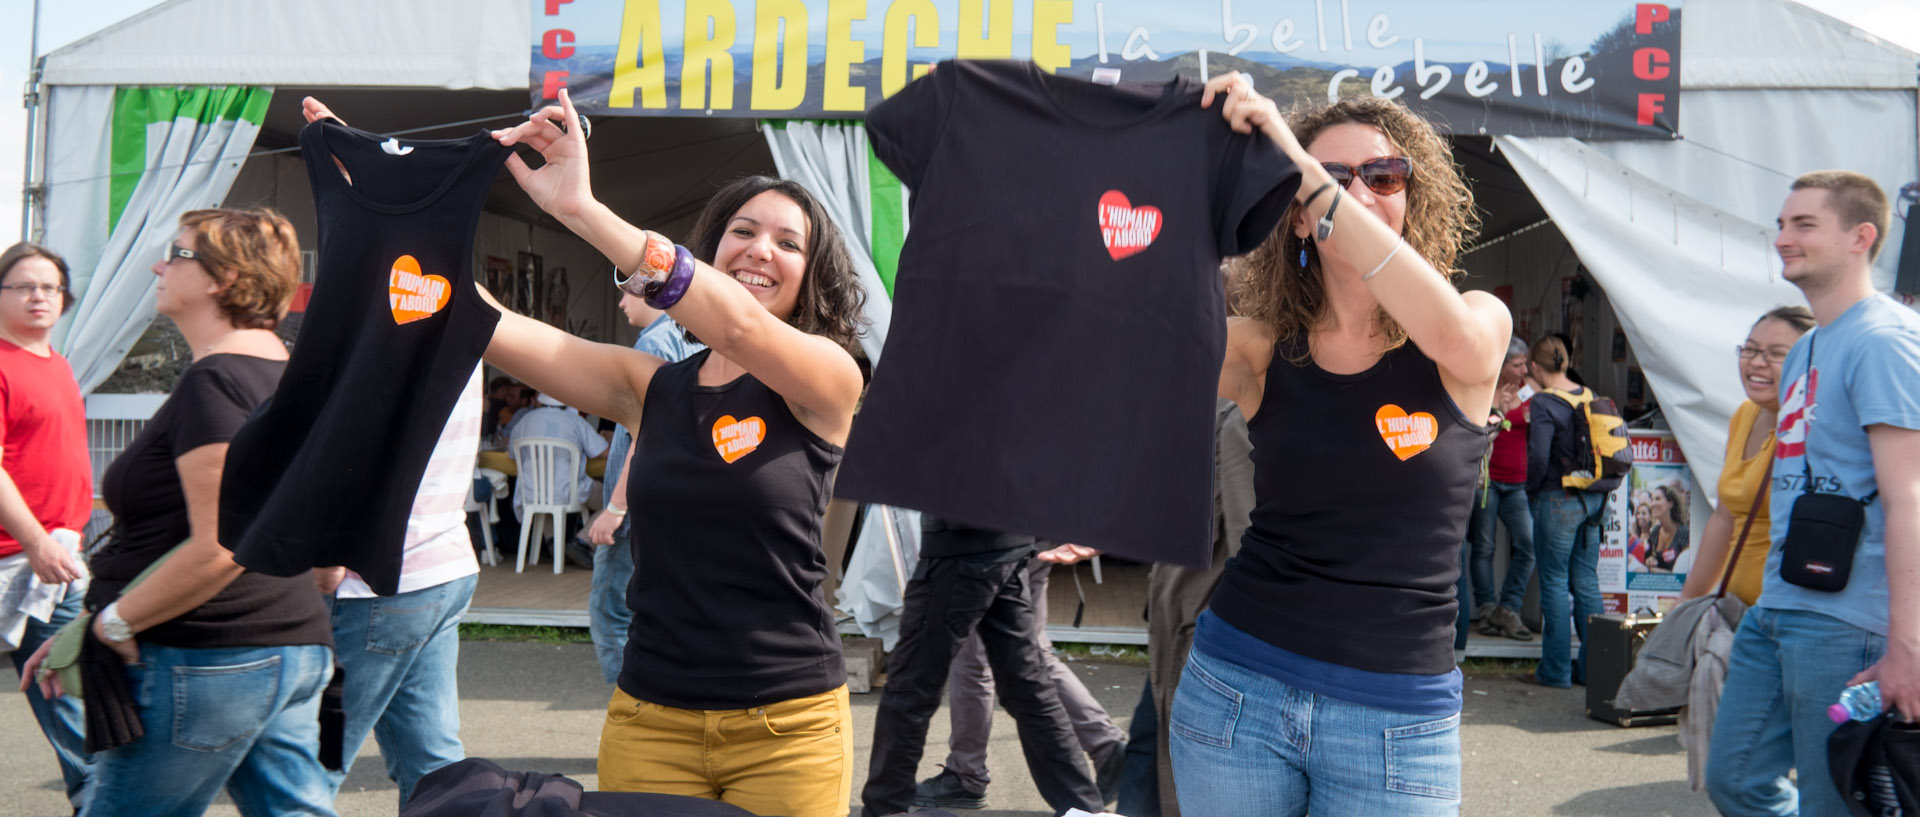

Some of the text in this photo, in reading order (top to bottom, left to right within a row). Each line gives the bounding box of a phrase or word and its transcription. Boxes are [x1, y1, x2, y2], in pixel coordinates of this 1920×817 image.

[1095, 0, 1400, 63] la belle
[608, 0, 1073, 111] ARDECHE
[1327, 33, 1595, 104] rebelle
[1634, 3, 1670, 126] PCF
[1099, 203, 1157, 232] L'HUMAIN
[1103, 227, 1152, 248] D'ABORD
[390, 267, 445, 300] L'HUMAIN
[390, 293, 438, 313] D'ABORD
[713, 420, 760, 443] L'HUMAIN
[1378, 415, 1432, 433] L'HUMAIN
[718, 433, 760, 457] D'ABORD
[1386, 431, 1433, 450] D'ABORD
